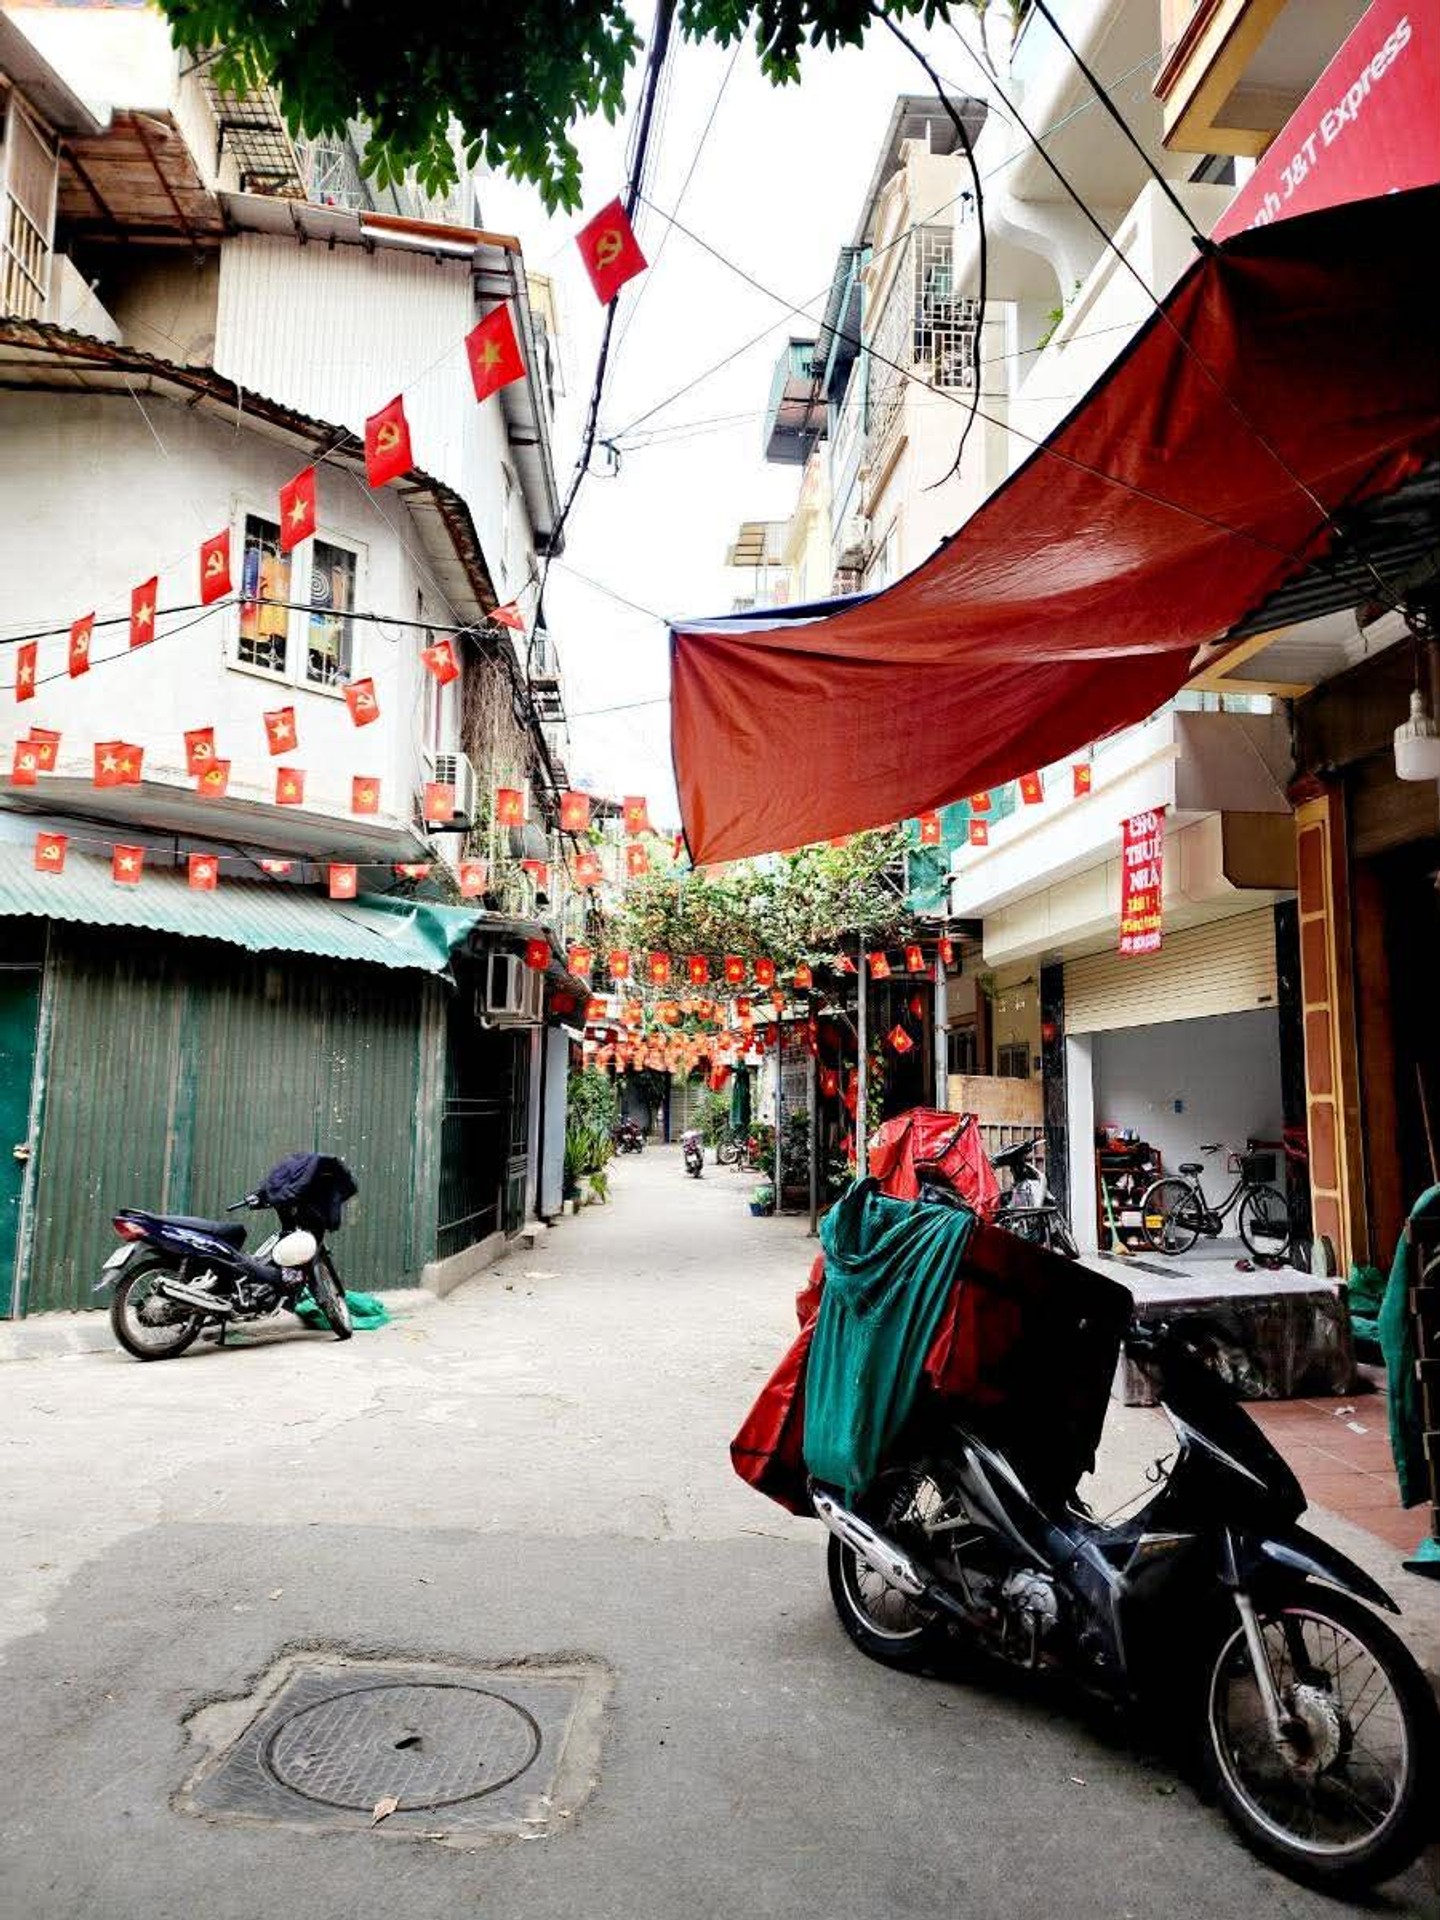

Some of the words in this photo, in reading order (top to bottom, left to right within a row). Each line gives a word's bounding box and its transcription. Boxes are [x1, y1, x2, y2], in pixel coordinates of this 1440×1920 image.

[1280, 132, 1318, 200] J&T
[1318, 14, 1413, 148] Express
[1128, 811, 1159, 838] CHO
[1125, 832, 1163, 867] THUÊ
[1129, 862, 1161, 893] NHÀ
